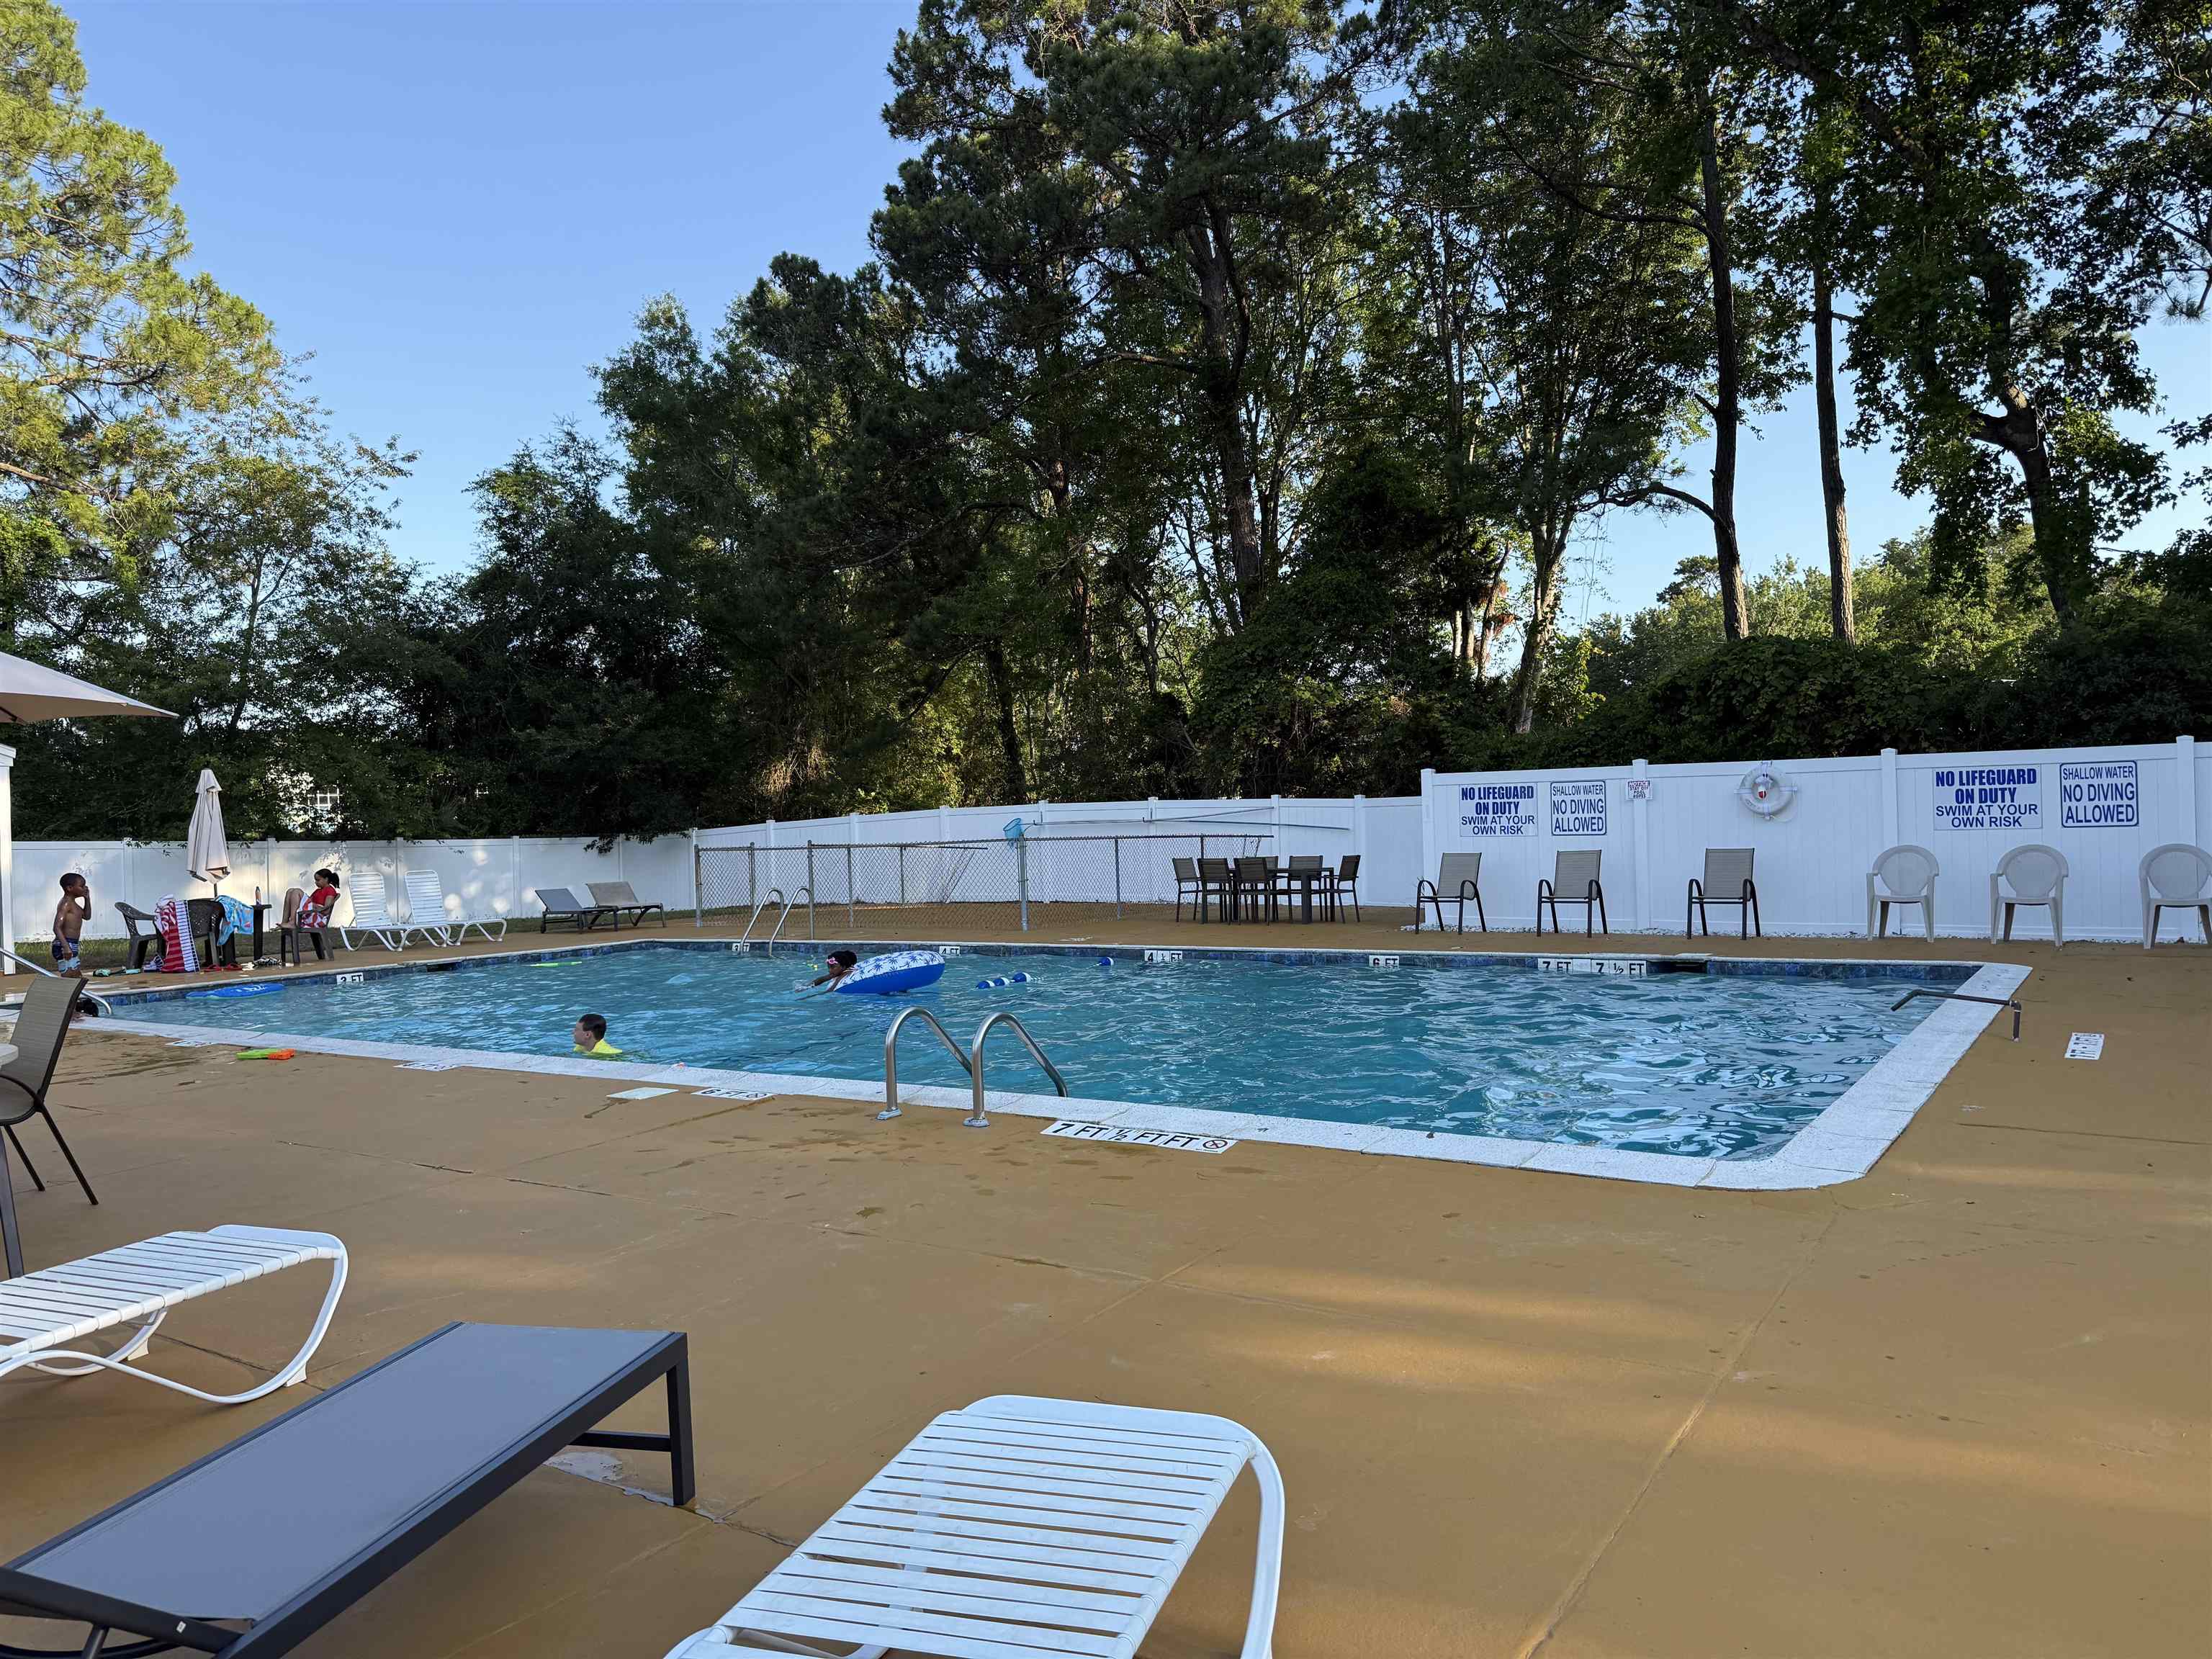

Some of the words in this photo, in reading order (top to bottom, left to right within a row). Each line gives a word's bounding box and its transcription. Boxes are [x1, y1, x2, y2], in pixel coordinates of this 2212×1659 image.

[1936, 771, 1955, 787] NO
[1959, 768, 2037, 786] LIFEGUARD
[2062, 766, 2103, 781] SHALLOW
[2105, 765, 2134, 778] WATER
[1461, 787, 1475, 801] NO
[1478, 786, 1534, 800] LIFEGUARD
[1552, 785, 1582, 796] SHALLOW
[1582, 784, 1604, 796] WATER
[1955, 788, 1974, 804] ON
[1979, 787, 2017, 804] DUTY
[2063, 783, 2083, 803] NO
[2087, 782, 2135, 801] DIVING
[1475, 801, 1490, 815] ON
[1491, 801, 1520, 815] DUTY
[1552, 799, 1568, 815] NO
[1570, 798, 1604, 814] DIVING
[1936, 805, 1972, 817] SWIM
[1977, 804, 1993, 816] AT
[1997, 804, 2038, 816] YOUR
[1461, 815, 1488, 825] SWIM
[1490, 815, 1503, 825] AT
[1505, 814, 1535, 824] YOUR
[2065, 804, 2135, 824] ALLOWED
[1554, 817, 1604, 832] ALLOWED
[1951, 817, 1984, 828] OWN
[1990, 815, 2023, 827] RISK
[1472, 825, 1497, 835] OWN
[1499, 824, 1524, 835] RISK
[1147, 952, 1154, 963] 4
[1171, 952, 1182, 963] FT
[1372, 957, 1381, 968] 6
[1385, 958, 1399, 968] FT
[1556, 961, 1572, 972] FT
[1596, 962, 1605, 974] 7
[1629, 963, 1645, 979] FT
[351, 974, 362, 984] FT
[1052, 1123, 1075, 1134] 7
[1074, 1125, 1109, 1138] FT
[1133, 1131, 1169, 1143] FT
[1163, 1135, 1200, 1148] FT
